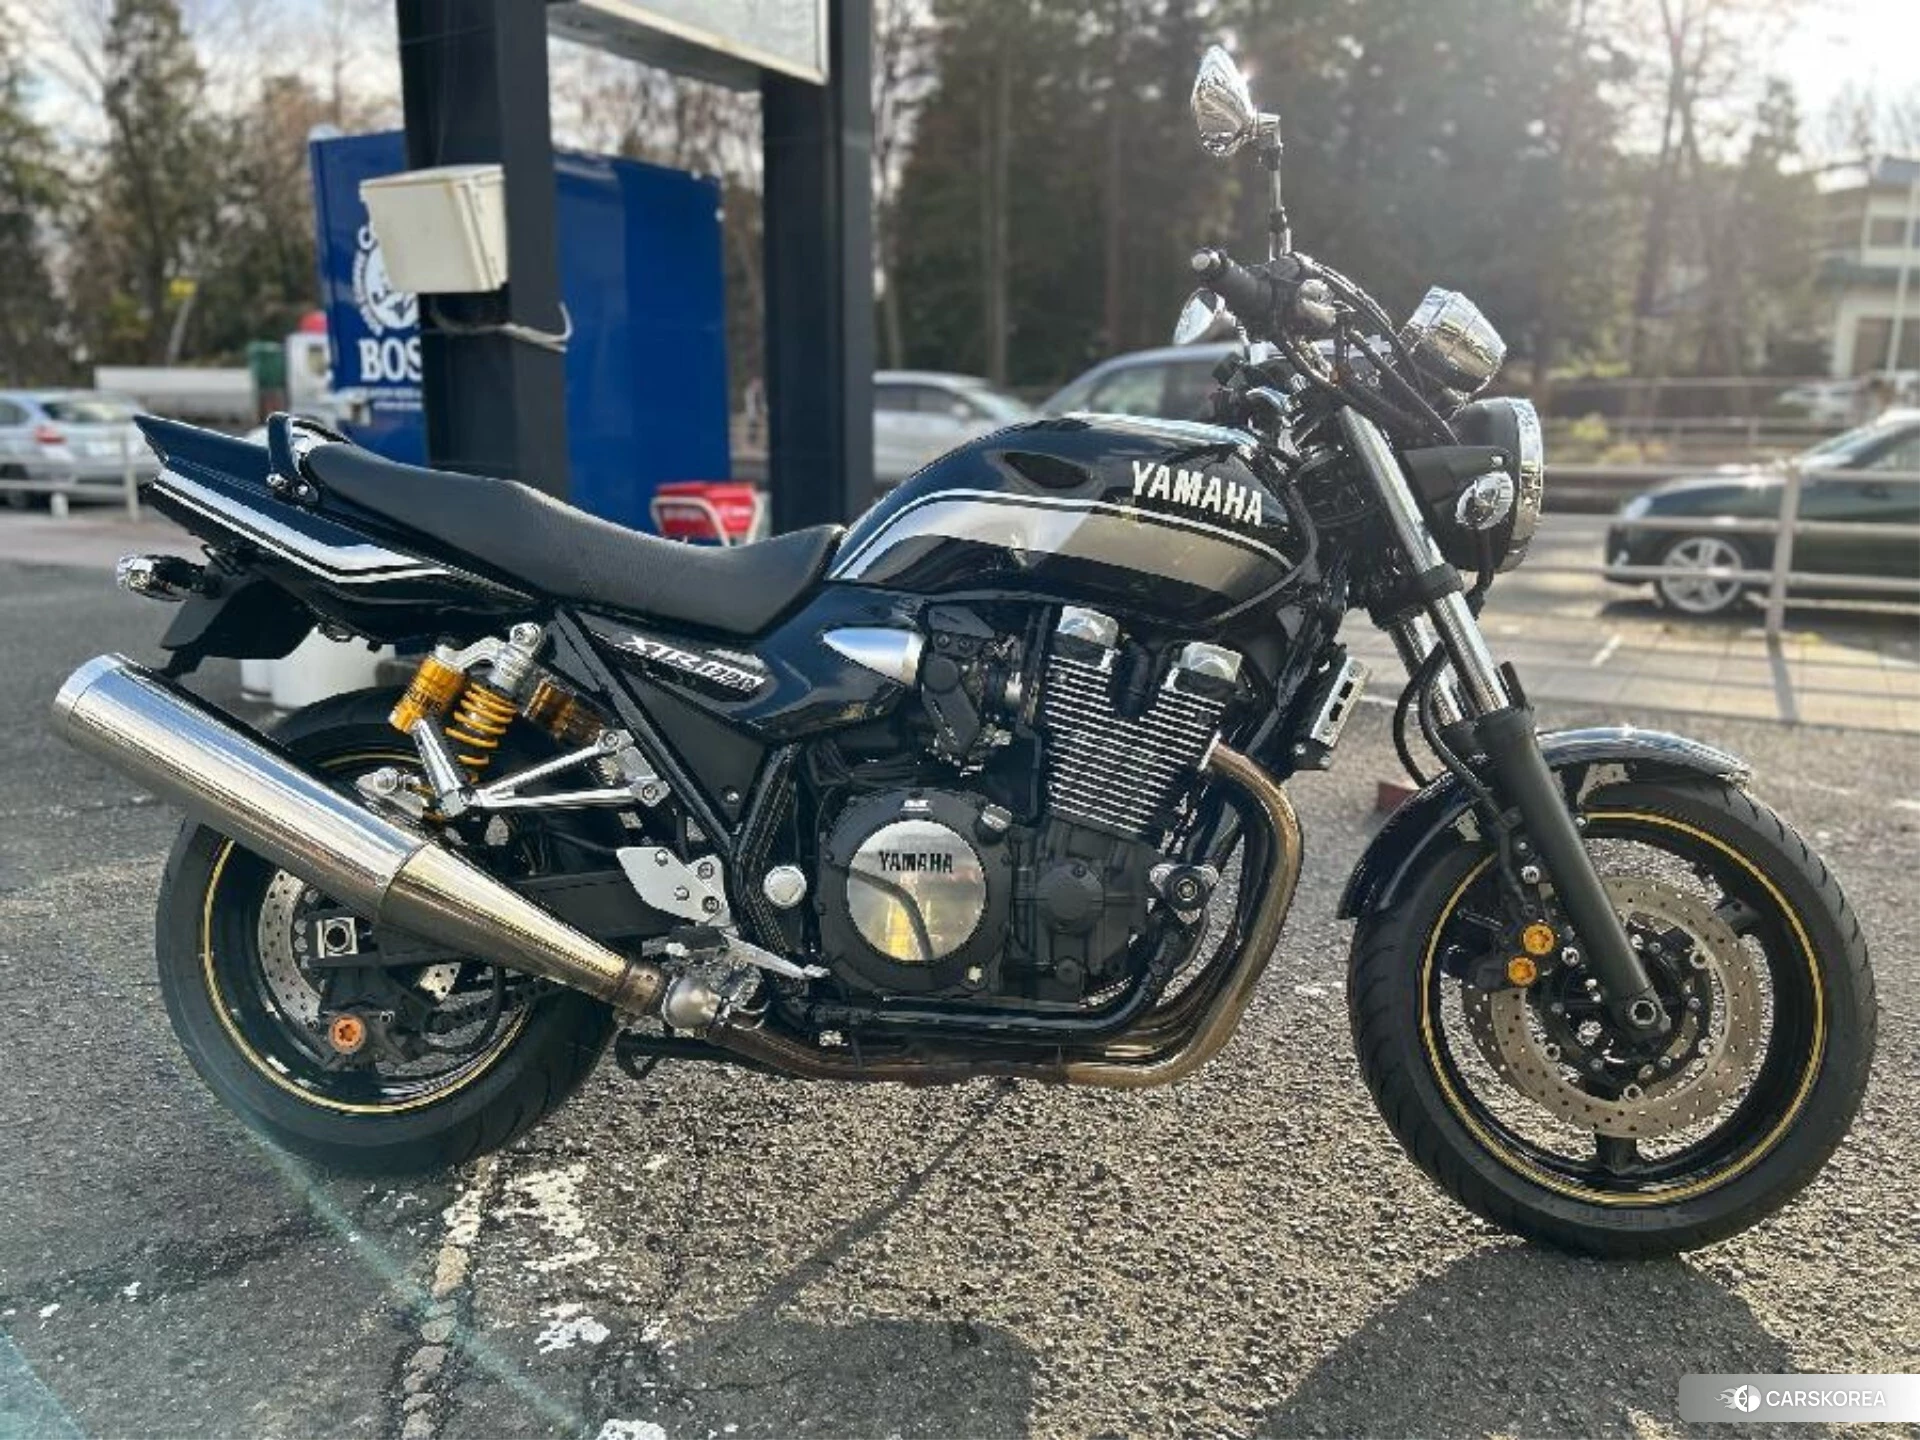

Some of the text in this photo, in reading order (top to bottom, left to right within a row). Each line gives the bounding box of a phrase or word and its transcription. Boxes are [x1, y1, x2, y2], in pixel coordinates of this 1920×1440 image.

[358, 337, 423, 382] BOS
[1132, 460, 1262, 527] YAMAHA
[878, 850, 953, 873] YAMAHA
